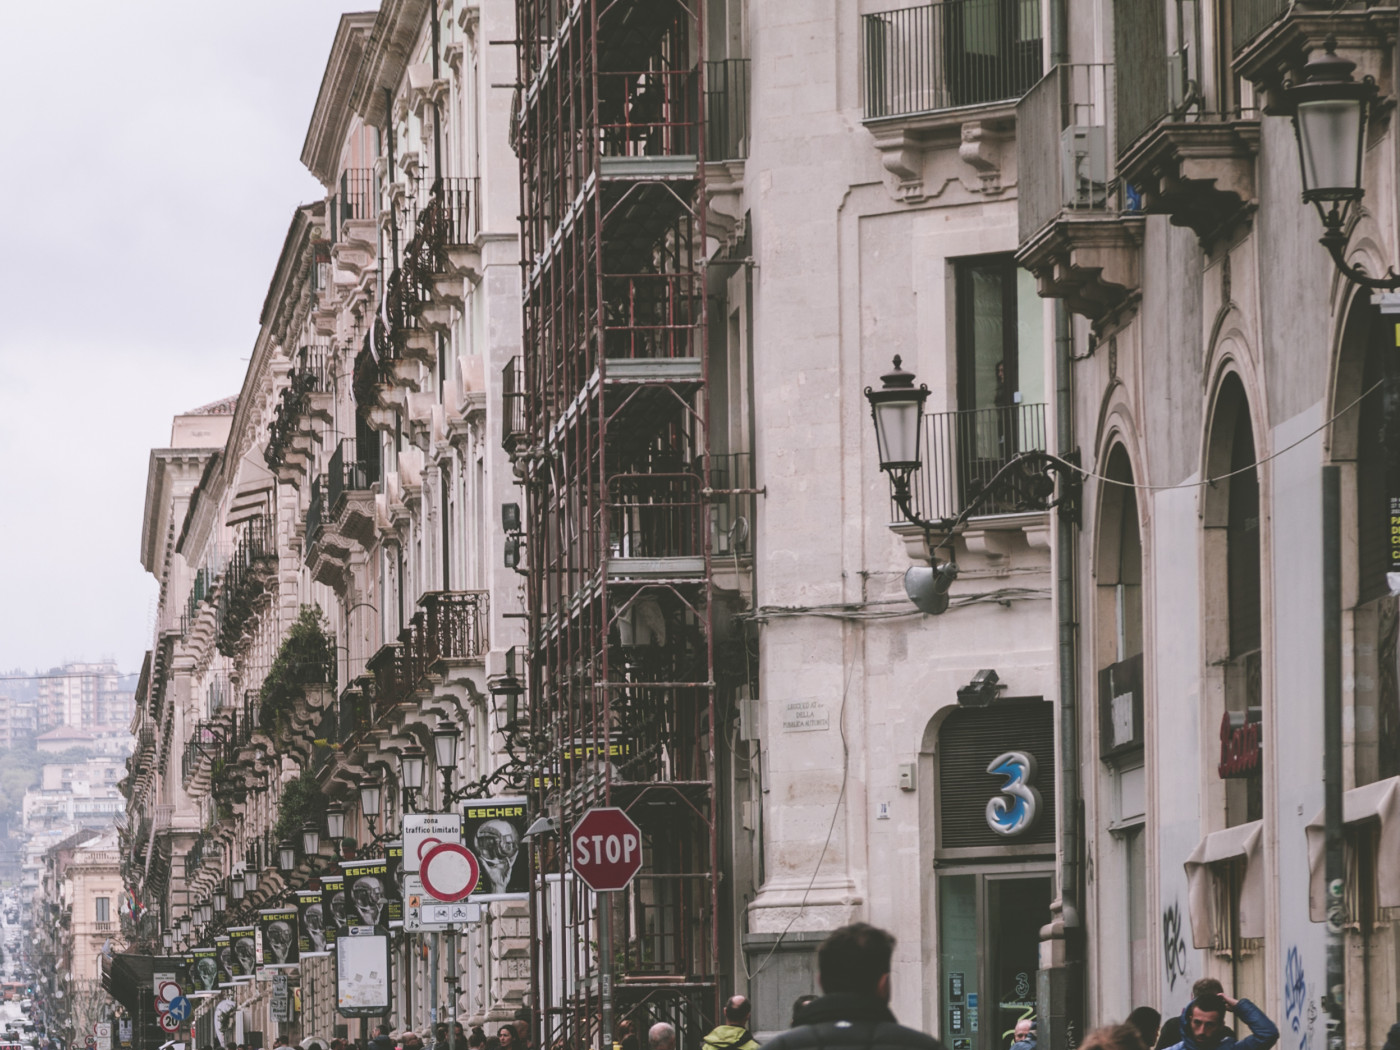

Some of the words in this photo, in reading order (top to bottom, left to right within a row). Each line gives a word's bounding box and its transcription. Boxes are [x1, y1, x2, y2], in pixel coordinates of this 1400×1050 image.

[986, 752, 1036, 834] 3
[468, 807, 523, 818] ESCHER
[405, 826, 431, 834] traffico
[432, 826, 459, 834] limitato
[576, 833, 637, 865] STOP
[345, 866, 387, 876] ESCHER
[165, 1015, 178, 1027] 20
